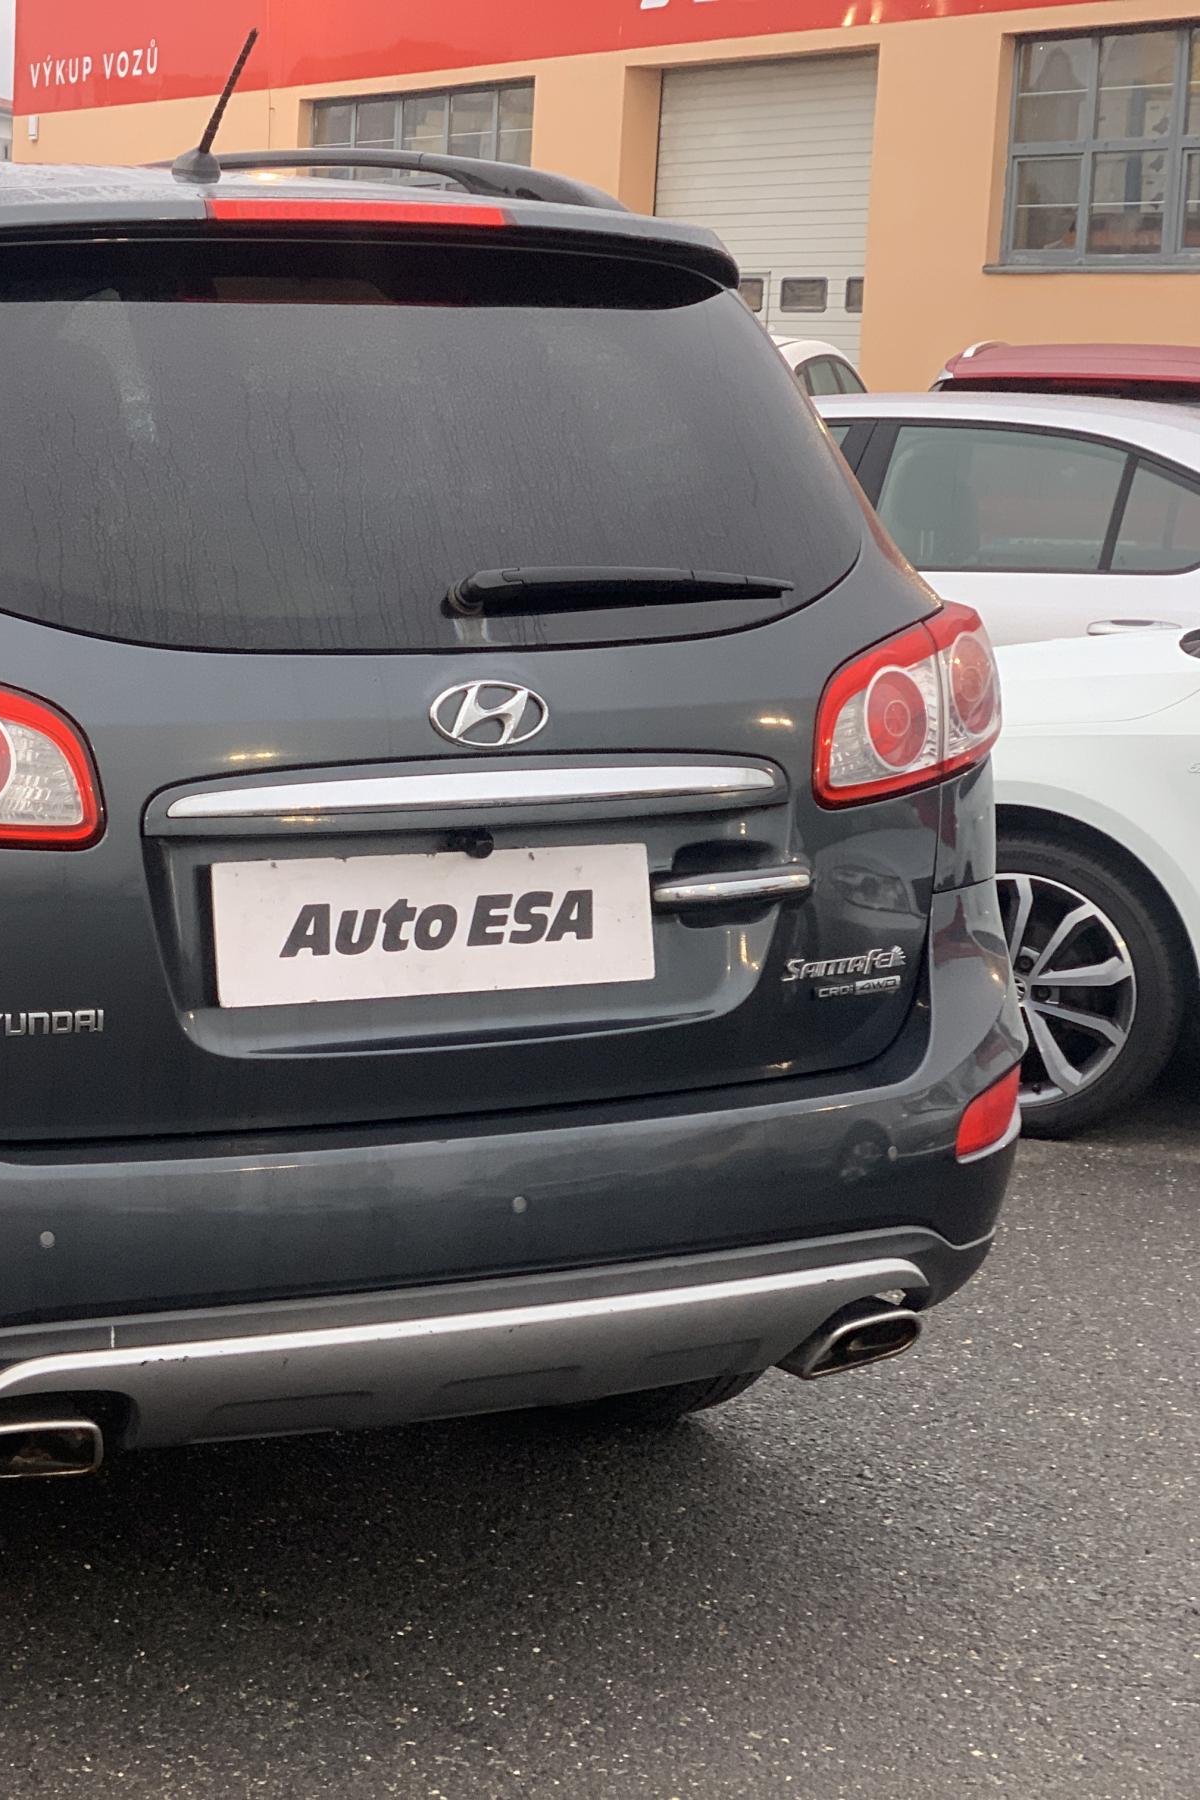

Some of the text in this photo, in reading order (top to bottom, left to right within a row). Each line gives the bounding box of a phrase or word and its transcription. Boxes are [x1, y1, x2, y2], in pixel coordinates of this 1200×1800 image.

[30, 38, 158, 89] VÝKUP VOZŮ
[278, 888, 594, 959] Auto ESA
[857, 976, 899, 992] 4WD
